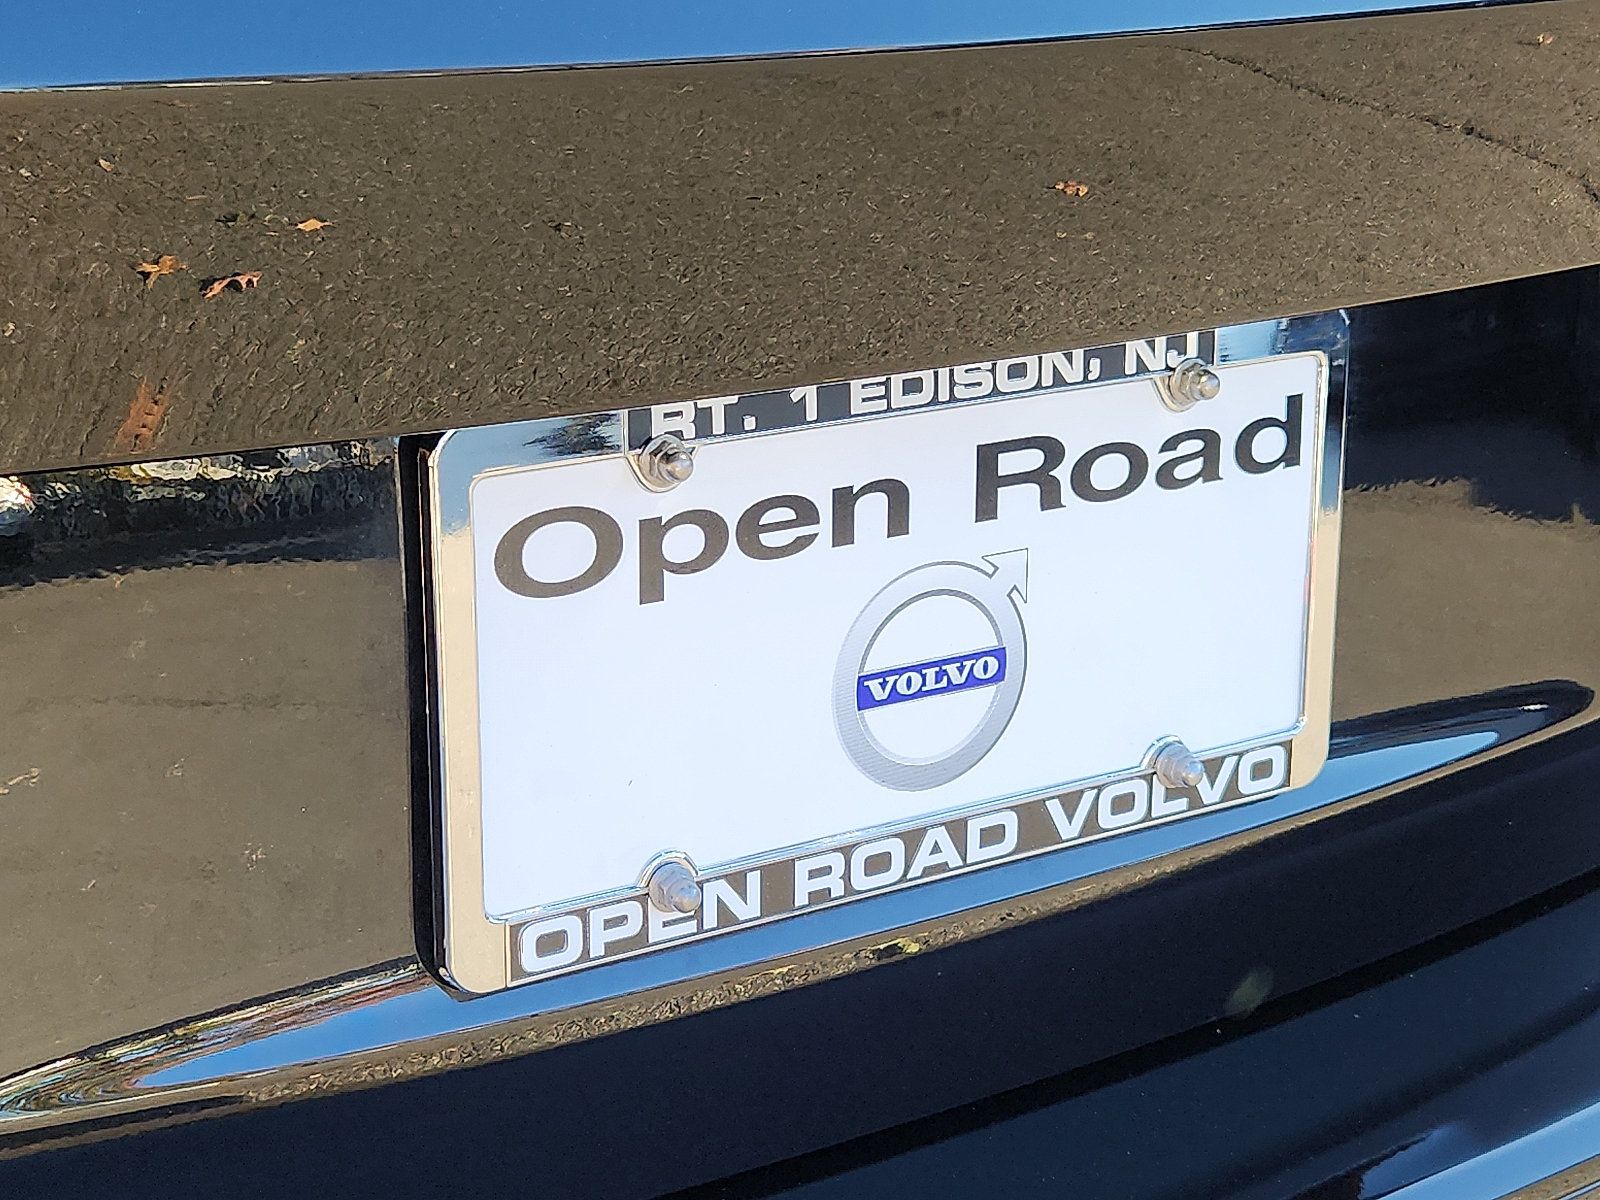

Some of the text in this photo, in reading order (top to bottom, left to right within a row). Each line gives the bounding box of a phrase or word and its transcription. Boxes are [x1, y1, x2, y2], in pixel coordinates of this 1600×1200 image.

[651, 331, 1199, 439] RT. 1 EDISON, NJ
[494, 394, 1304, 605] Open Road
[864, 656, 999, 701] VOLVO
[794, 810, 1020, 908] ROAD
[1045, 744, 1288, 842] VOLVO
